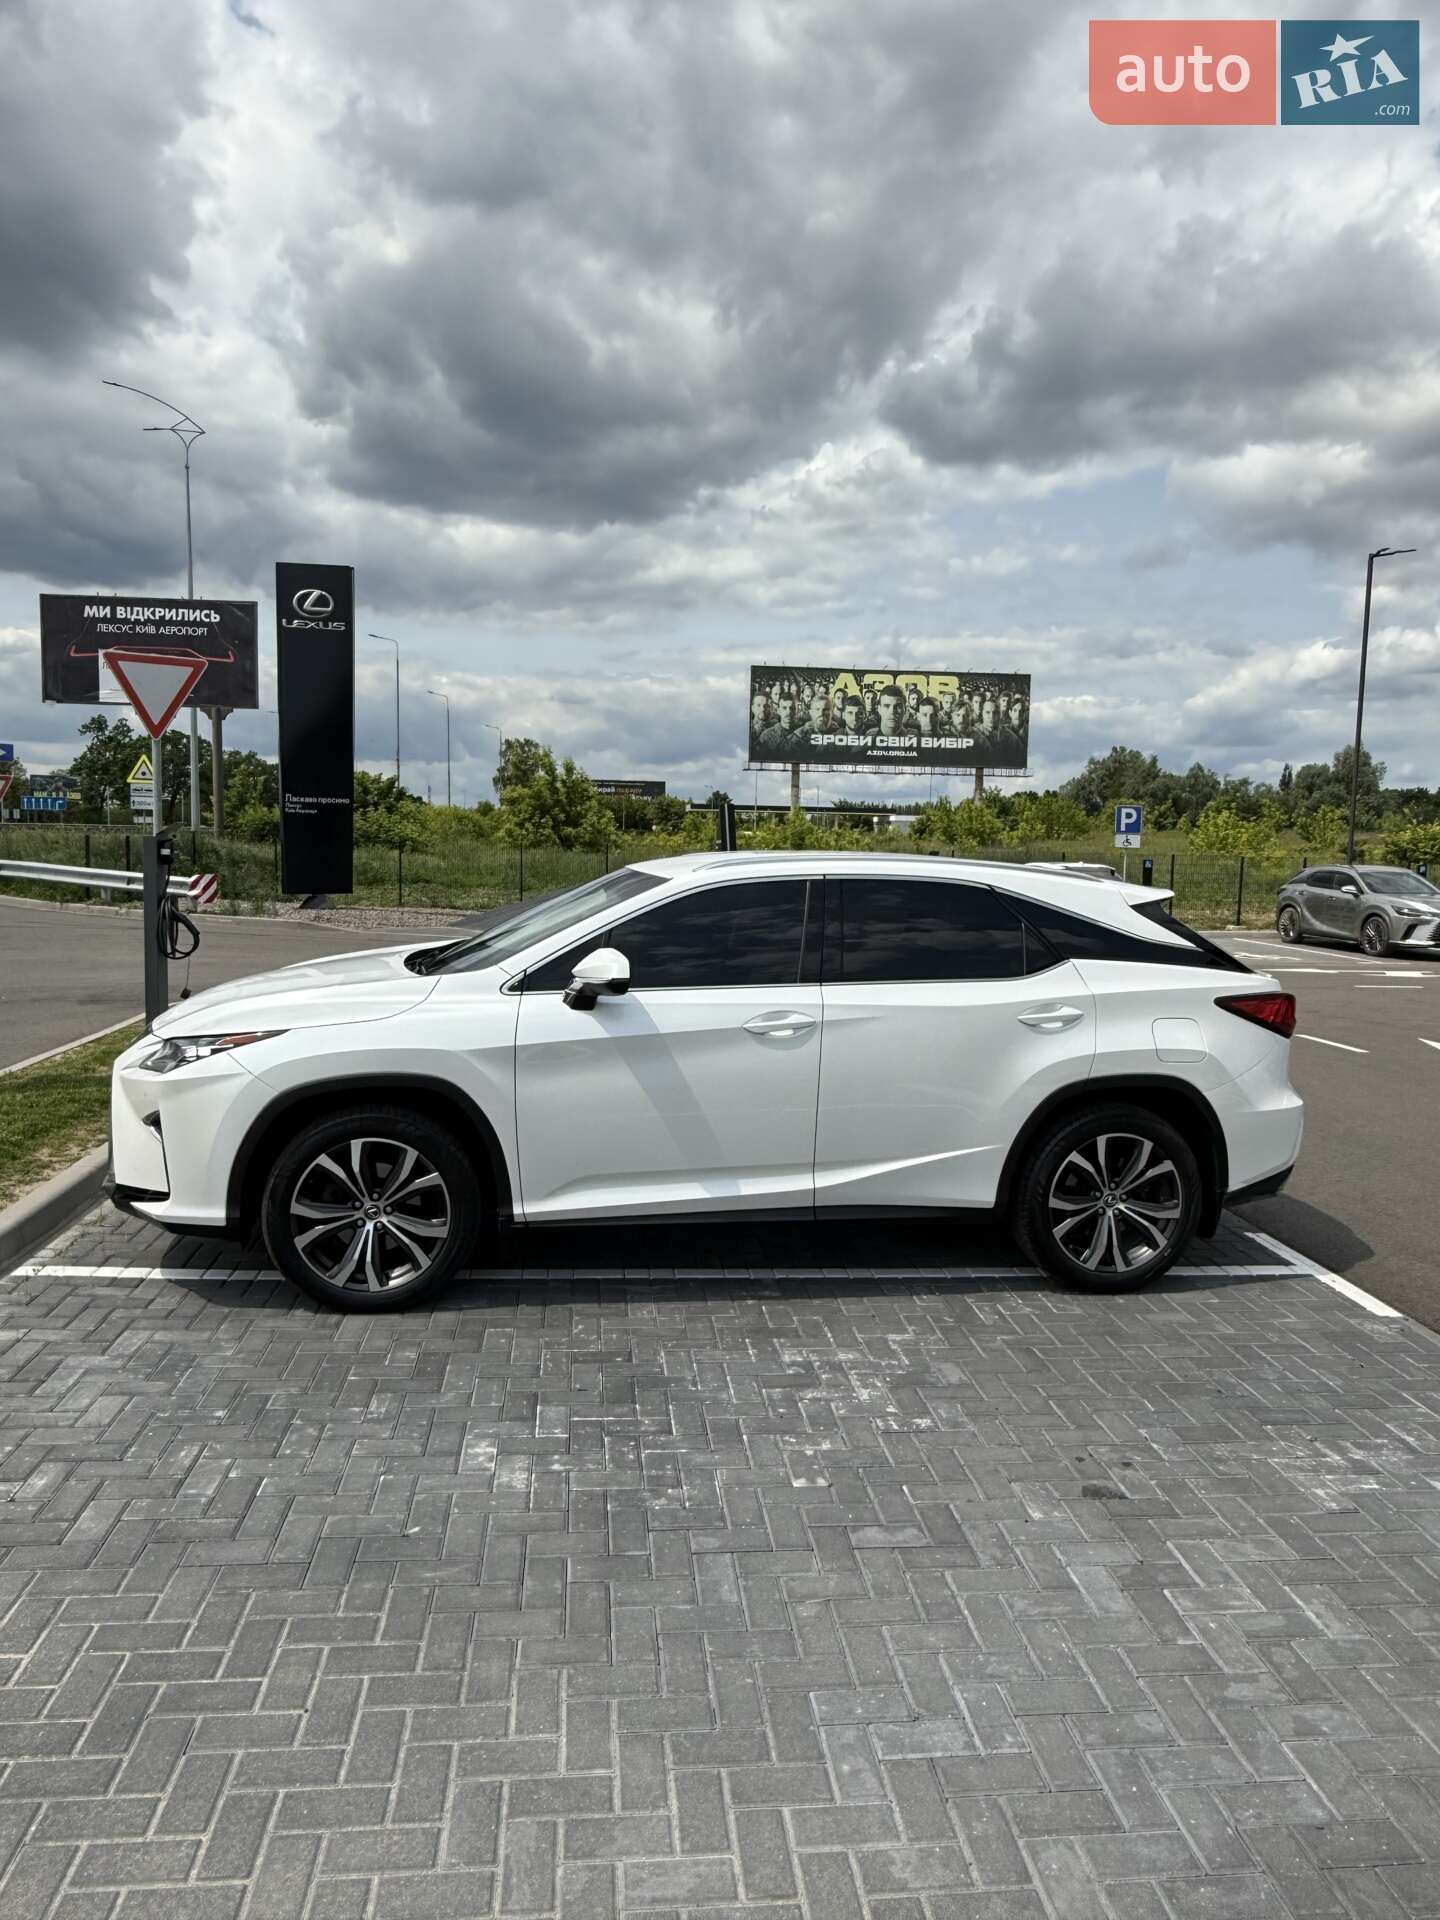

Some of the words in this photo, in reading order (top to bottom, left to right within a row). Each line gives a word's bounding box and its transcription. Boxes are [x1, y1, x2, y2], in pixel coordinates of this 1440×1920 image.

[83, 605, 111, 618] МИ
[116, 606, 221, 623] ВІДКРИЛИСЬ
[96, 623, 133, 634] ЛЕКСУС
[135, 623, 156, 635] КИЇВ
[158, 626, 208, 637] АЕРОПОРТ
[281, 618, 346, 631] LEXUS
[810, 734, 873, 746] ЗРОБИ
[875, 735, 918, 748] СВІЙ
[920, 736, 974, 749] ВИБІР
[1120, 808, 1137, 831] P
